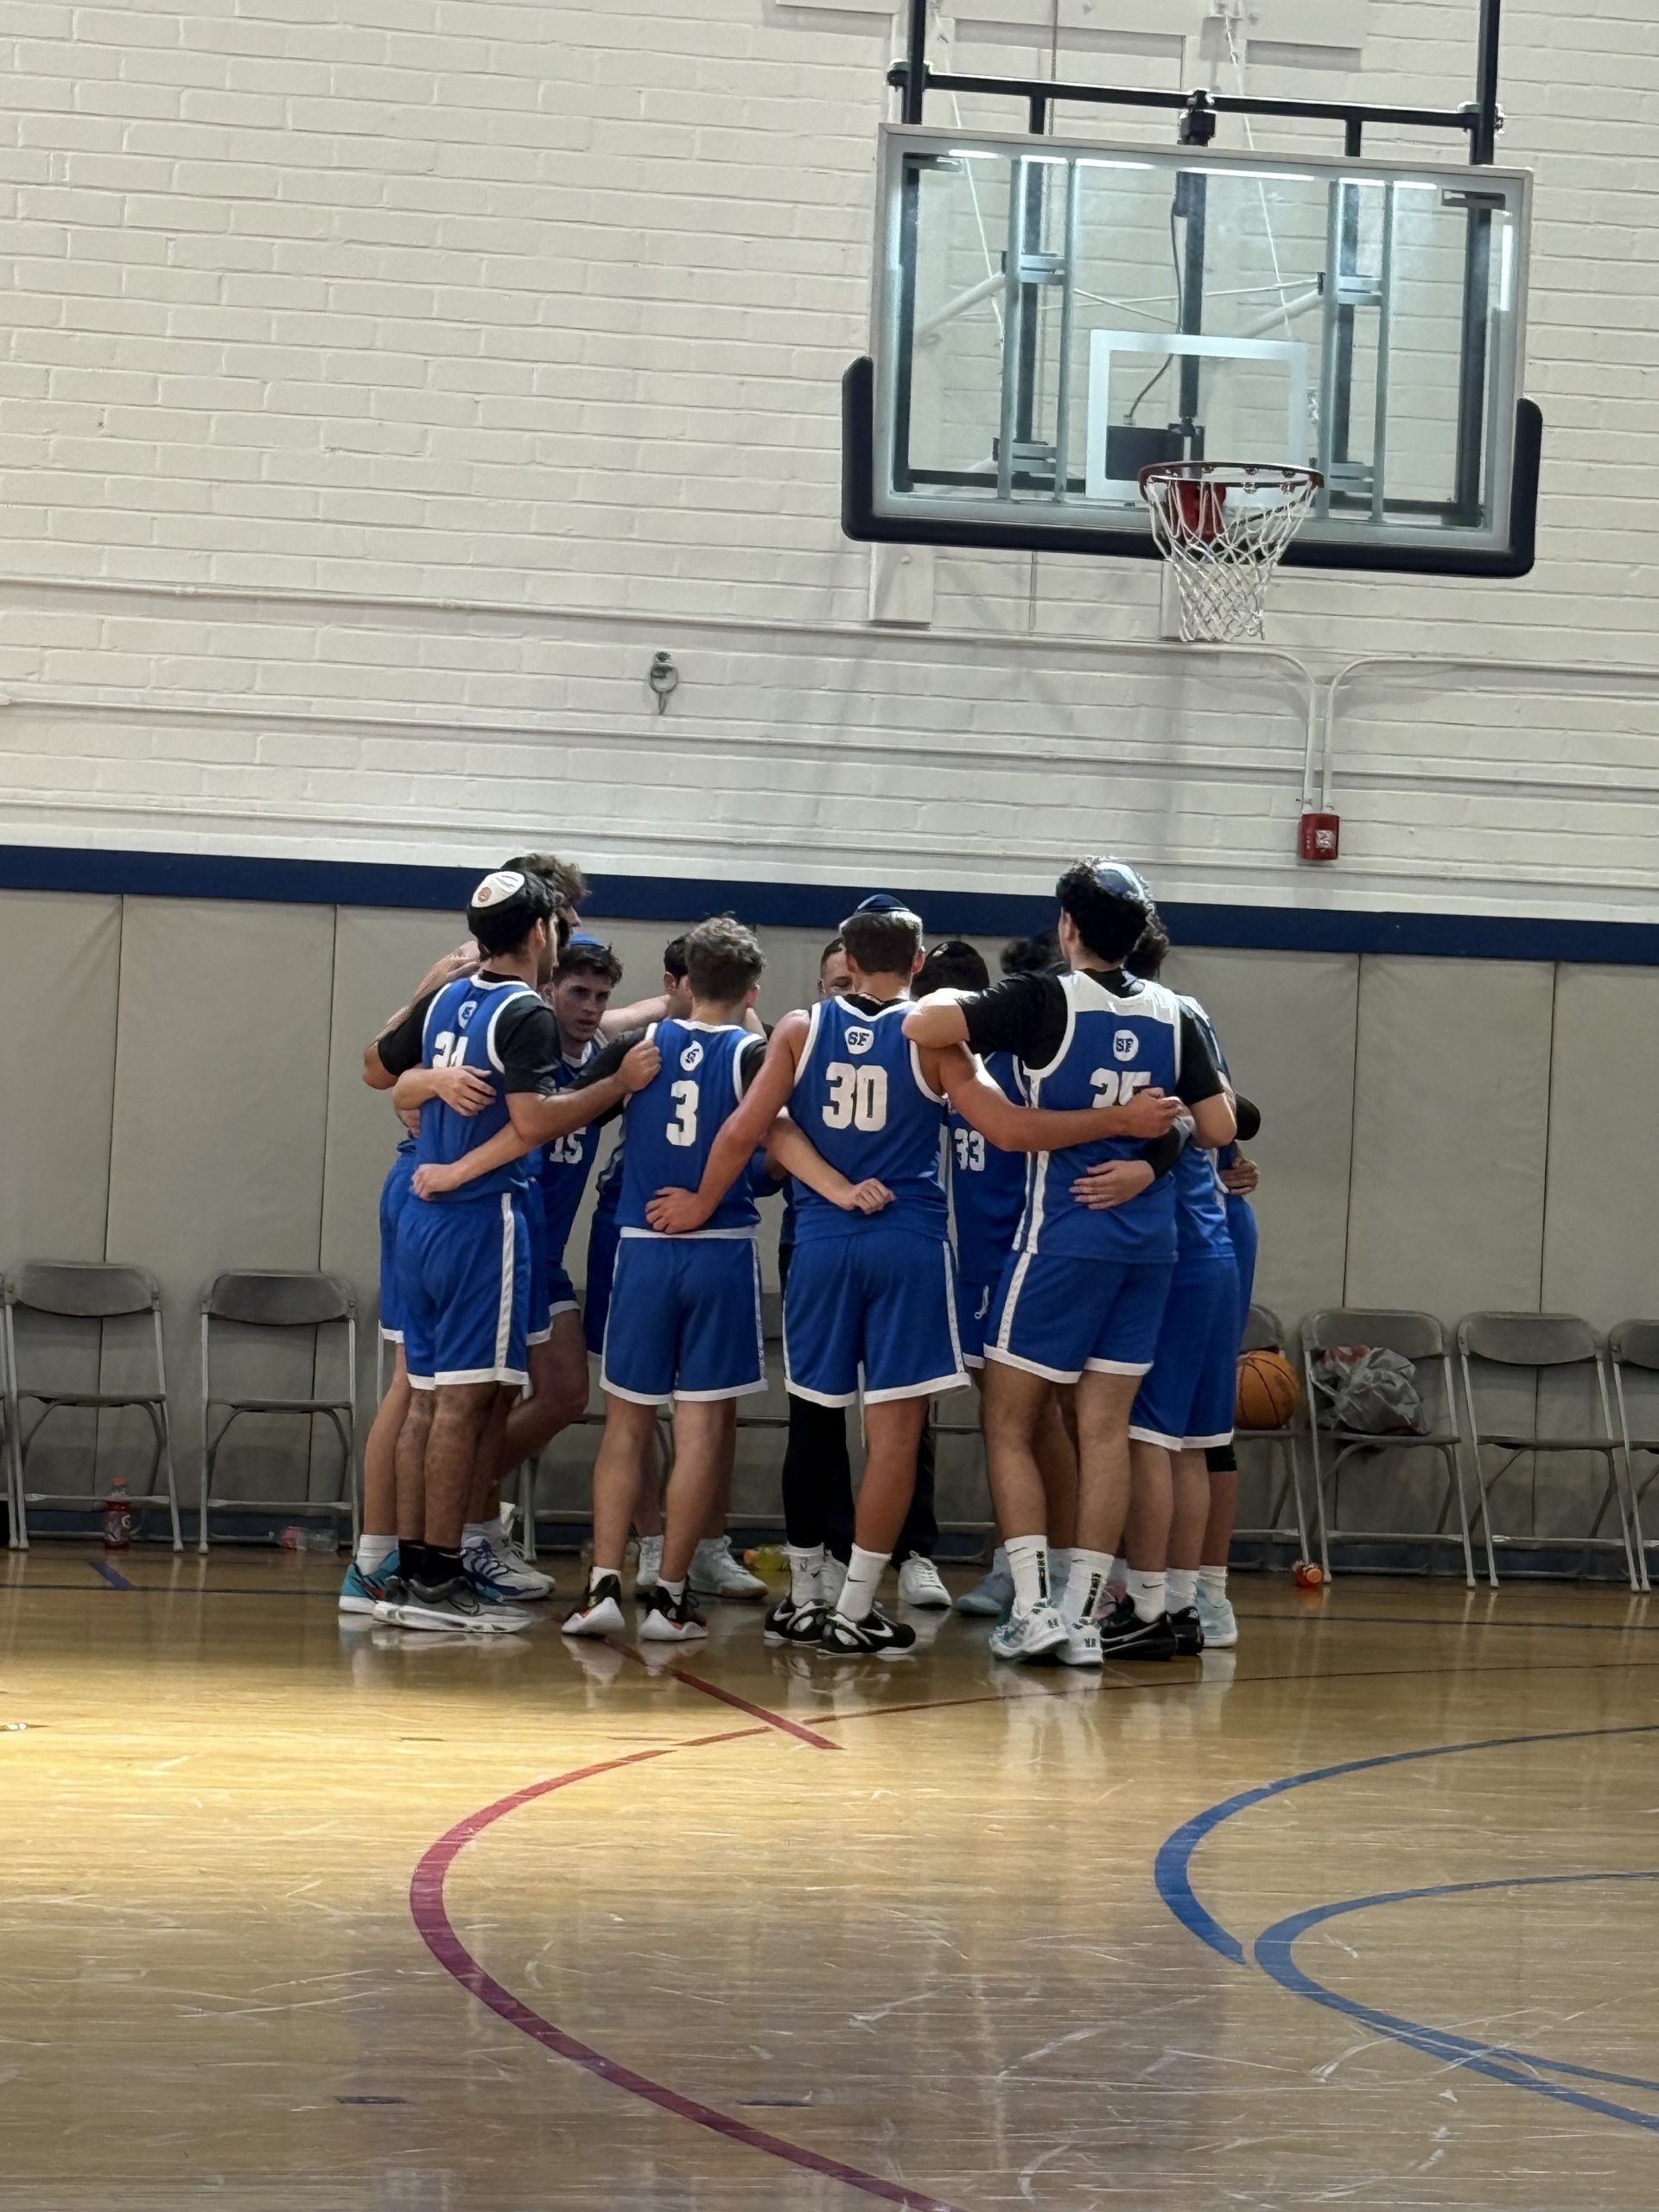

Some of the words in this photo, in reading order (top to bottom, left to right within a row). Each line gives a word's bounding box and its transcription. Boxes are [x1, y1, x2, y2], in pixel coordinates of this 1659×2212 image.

[848, 1031, 870, 1046] SF
[1116, 1037, 1134, 1052] SF
[666, 1080, 699, 1147] 3
[822, 1061, 887, 1132] 30
[549, 1126, 587, 1165] 15
[954, 1128, 985, 1172] 33
